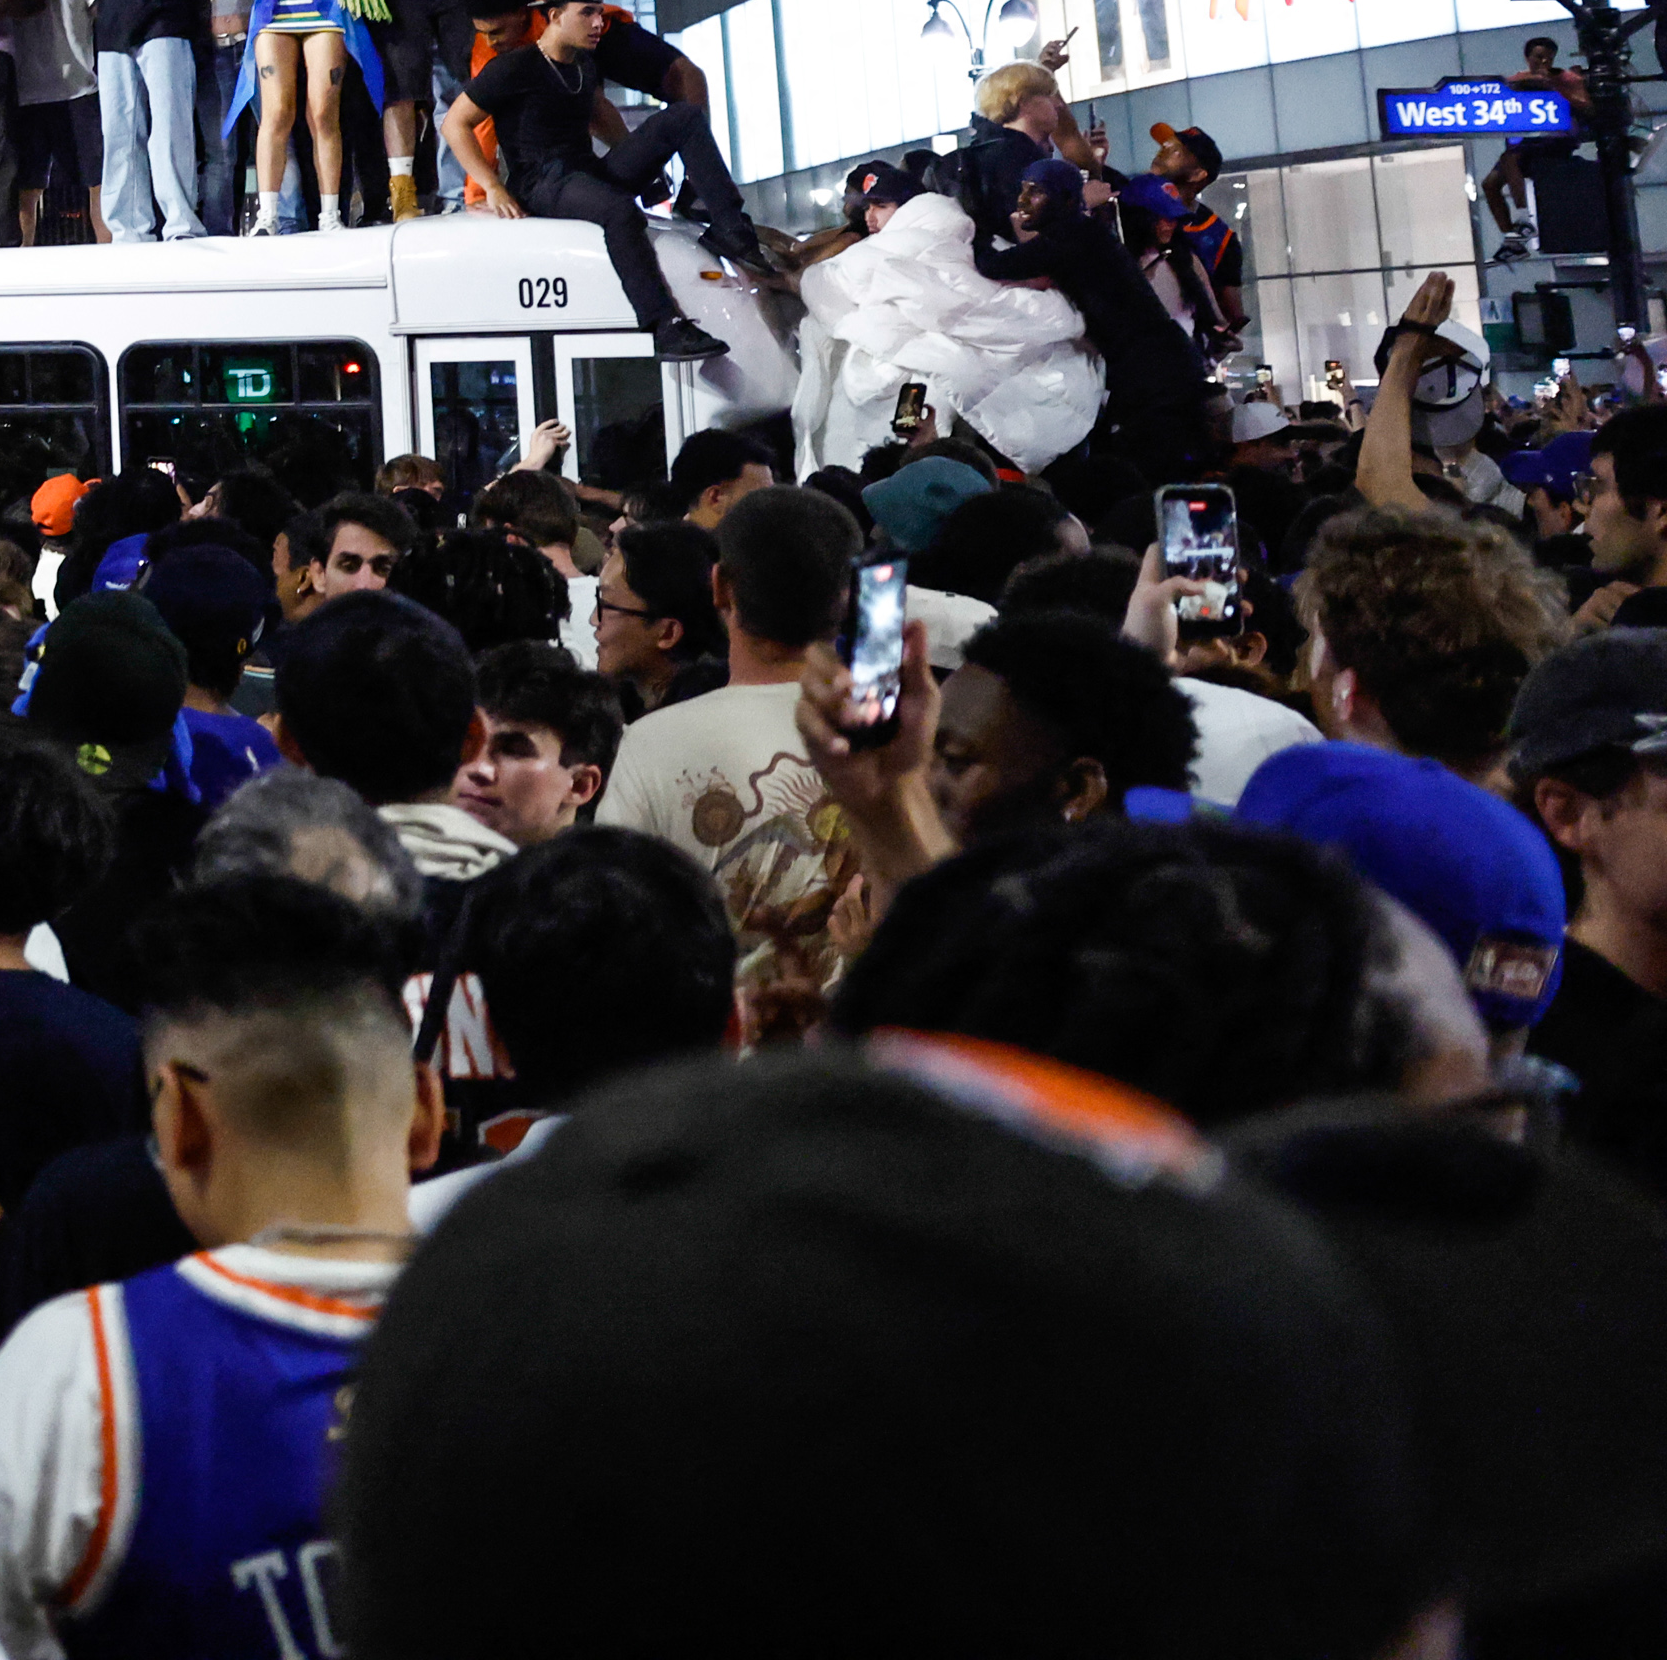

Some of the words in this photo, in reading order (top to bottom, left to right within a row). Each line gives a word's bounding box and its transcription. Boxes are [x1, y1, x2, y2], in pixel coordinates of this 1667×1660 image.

[1449, 83, 1472, 95] 100
[1479, 83, 1501, 95] 172
[1396, 101, 1468, 127] West
[1472, 97, 1523, 126] 34th
[1528, 98, 1560, 124] St
[518, 277, 569, 309] 029
[228, 368, 271, 398] TD
